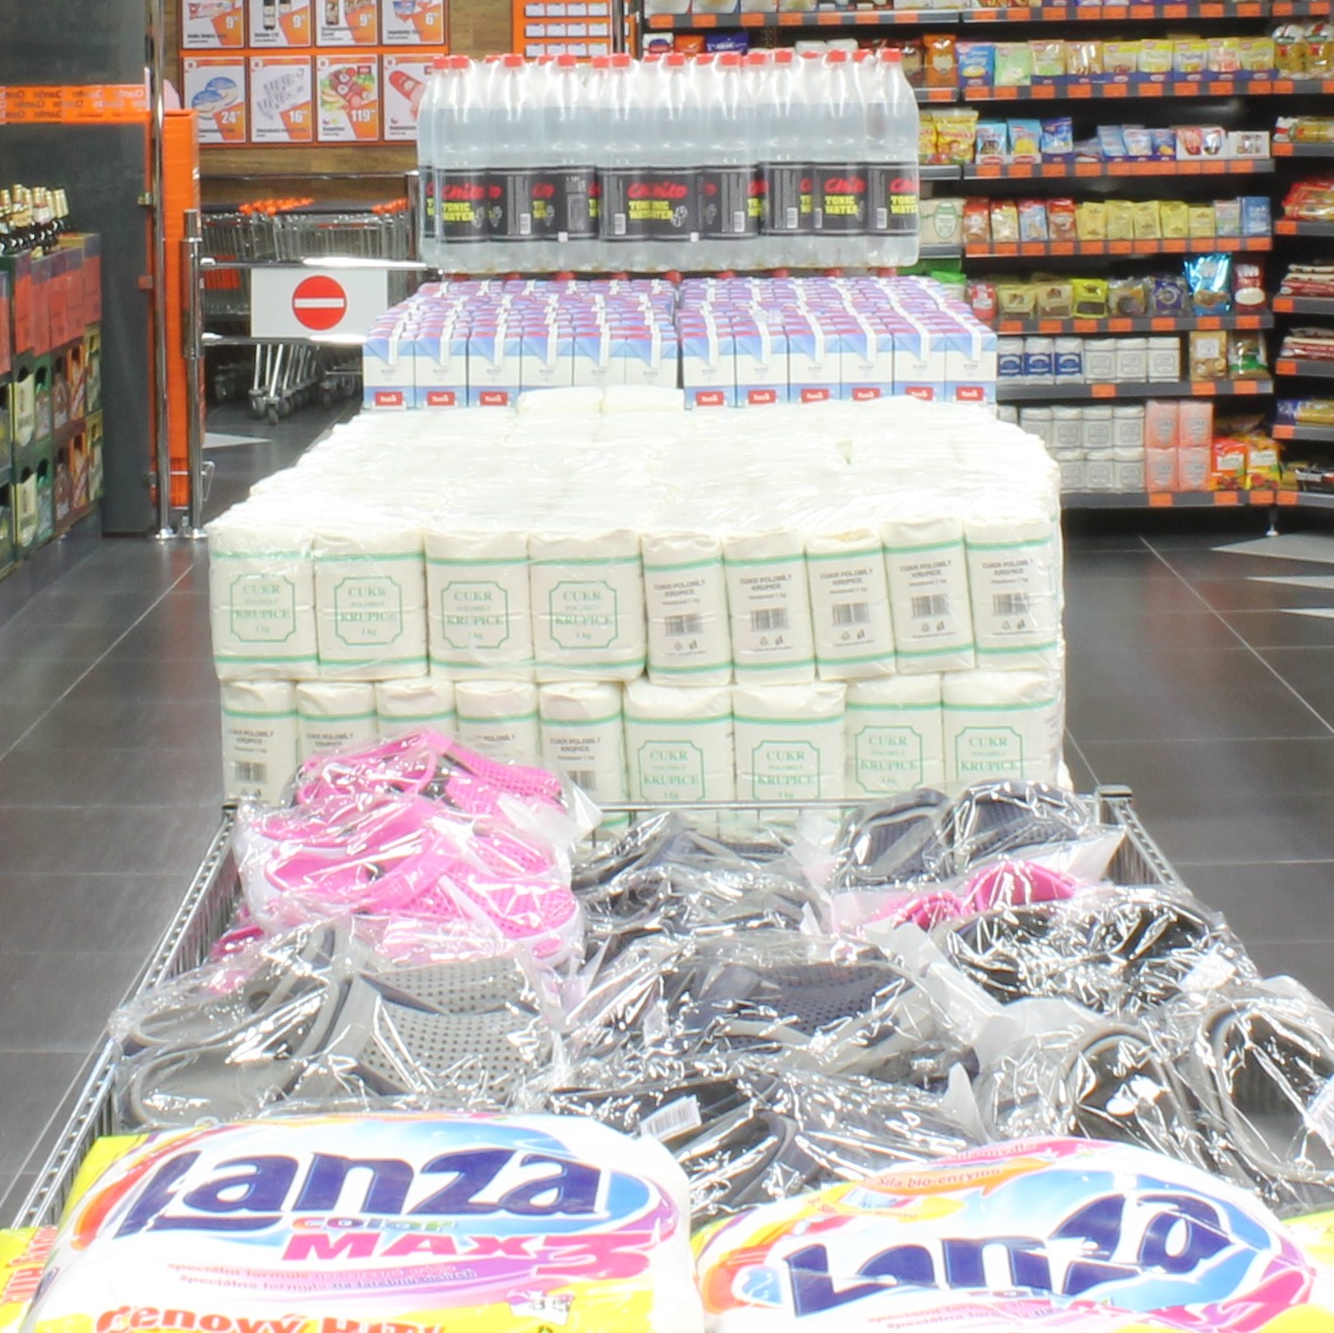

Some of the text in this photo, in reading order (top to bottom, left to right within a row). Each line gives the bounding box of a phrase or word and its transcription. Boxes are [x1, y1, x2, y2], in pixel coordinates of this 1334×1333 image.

[825, 195, 856, 205] TONIC
[825, 204, 858, 215] WATER
[243, 584, 280, 595] CUKR
[348, 586, 387, 598] CUKR
[454, 591, 493, 602] CUKR
[563, 591, 601, 601] CUKR
[868, 735, 907, 747] CUKR
[969, 735, 1008, 747] CUKR
[650, 750, 688, 761] CUKR
[765, 750, 806, 762] CUKR
[115, 1147, 604, 1238] Lanza
[291, 1216, 458, 1232] color
[783, 1190, 1235, 1318] Lanza
